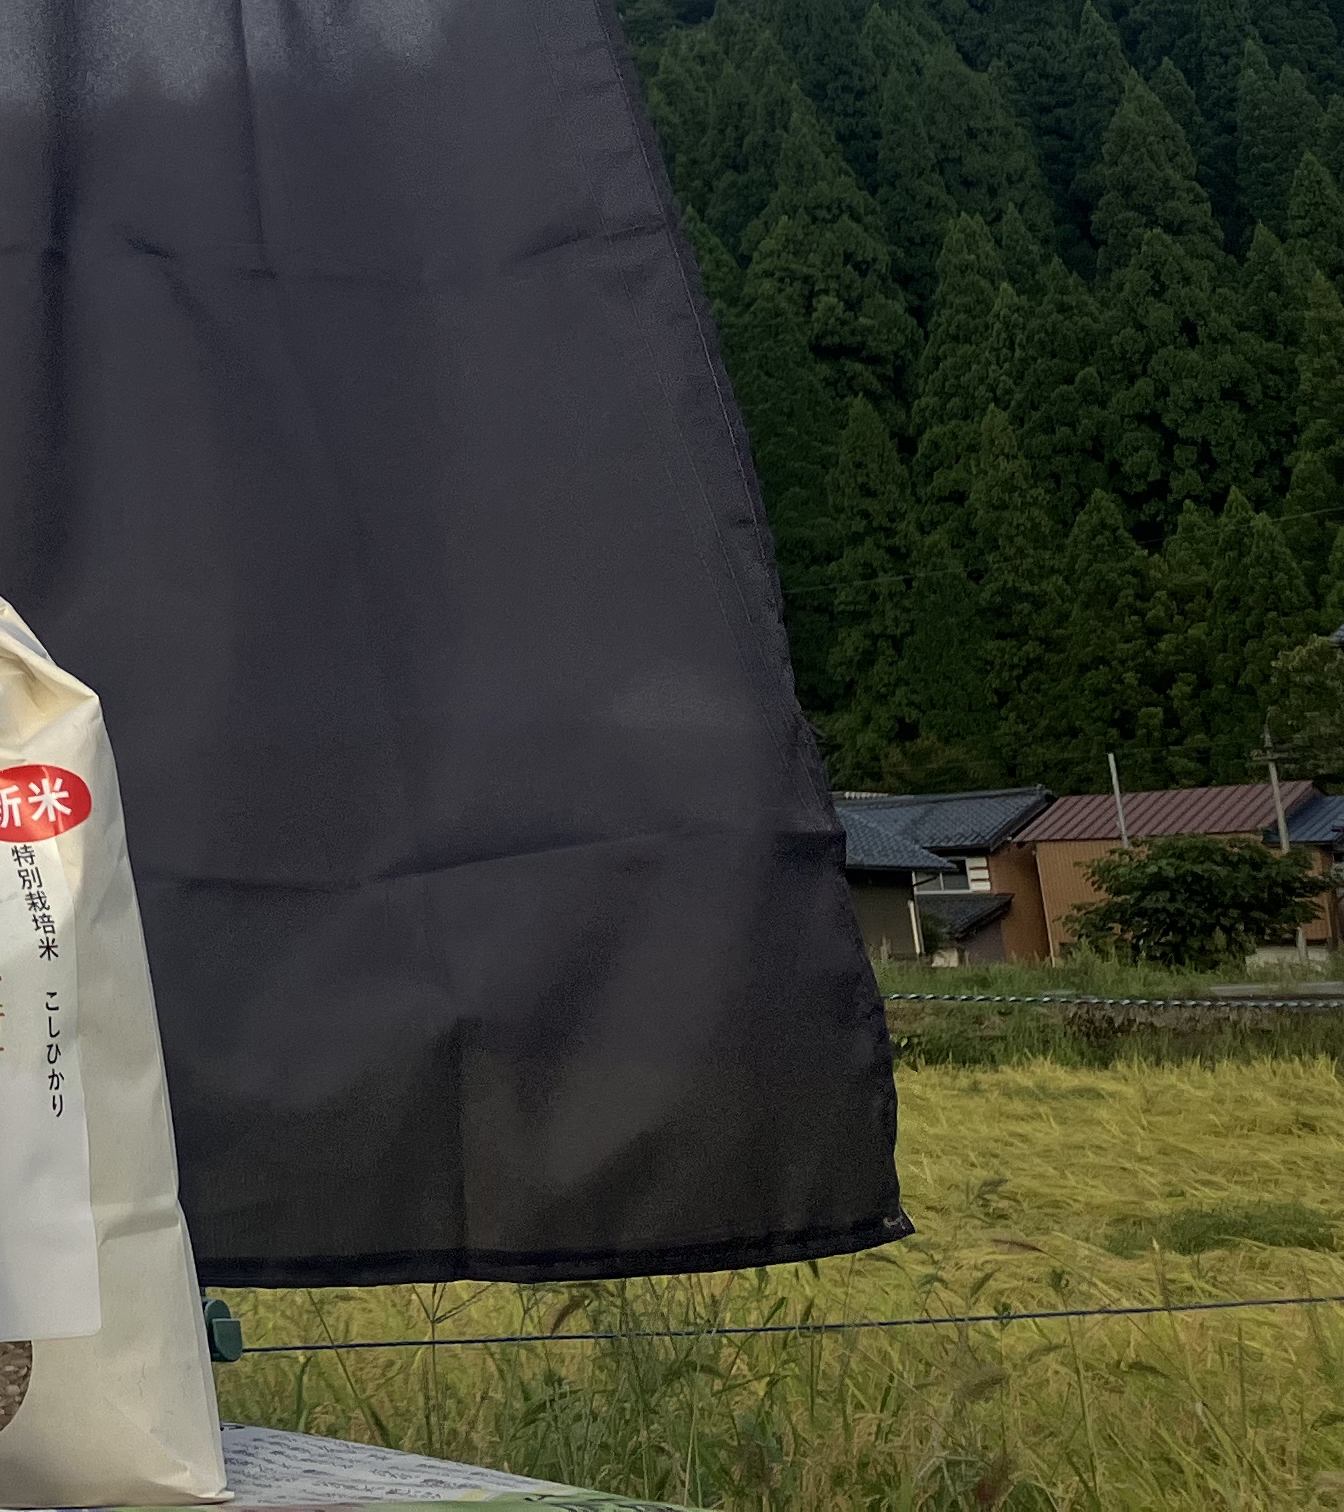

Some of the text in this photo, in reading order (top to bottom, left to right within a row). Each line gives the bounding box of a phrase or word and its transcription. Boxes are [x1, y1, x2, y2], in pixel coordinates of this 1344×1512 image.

[12, 844, 66, 1118] 特別栽培米 こしひかり
